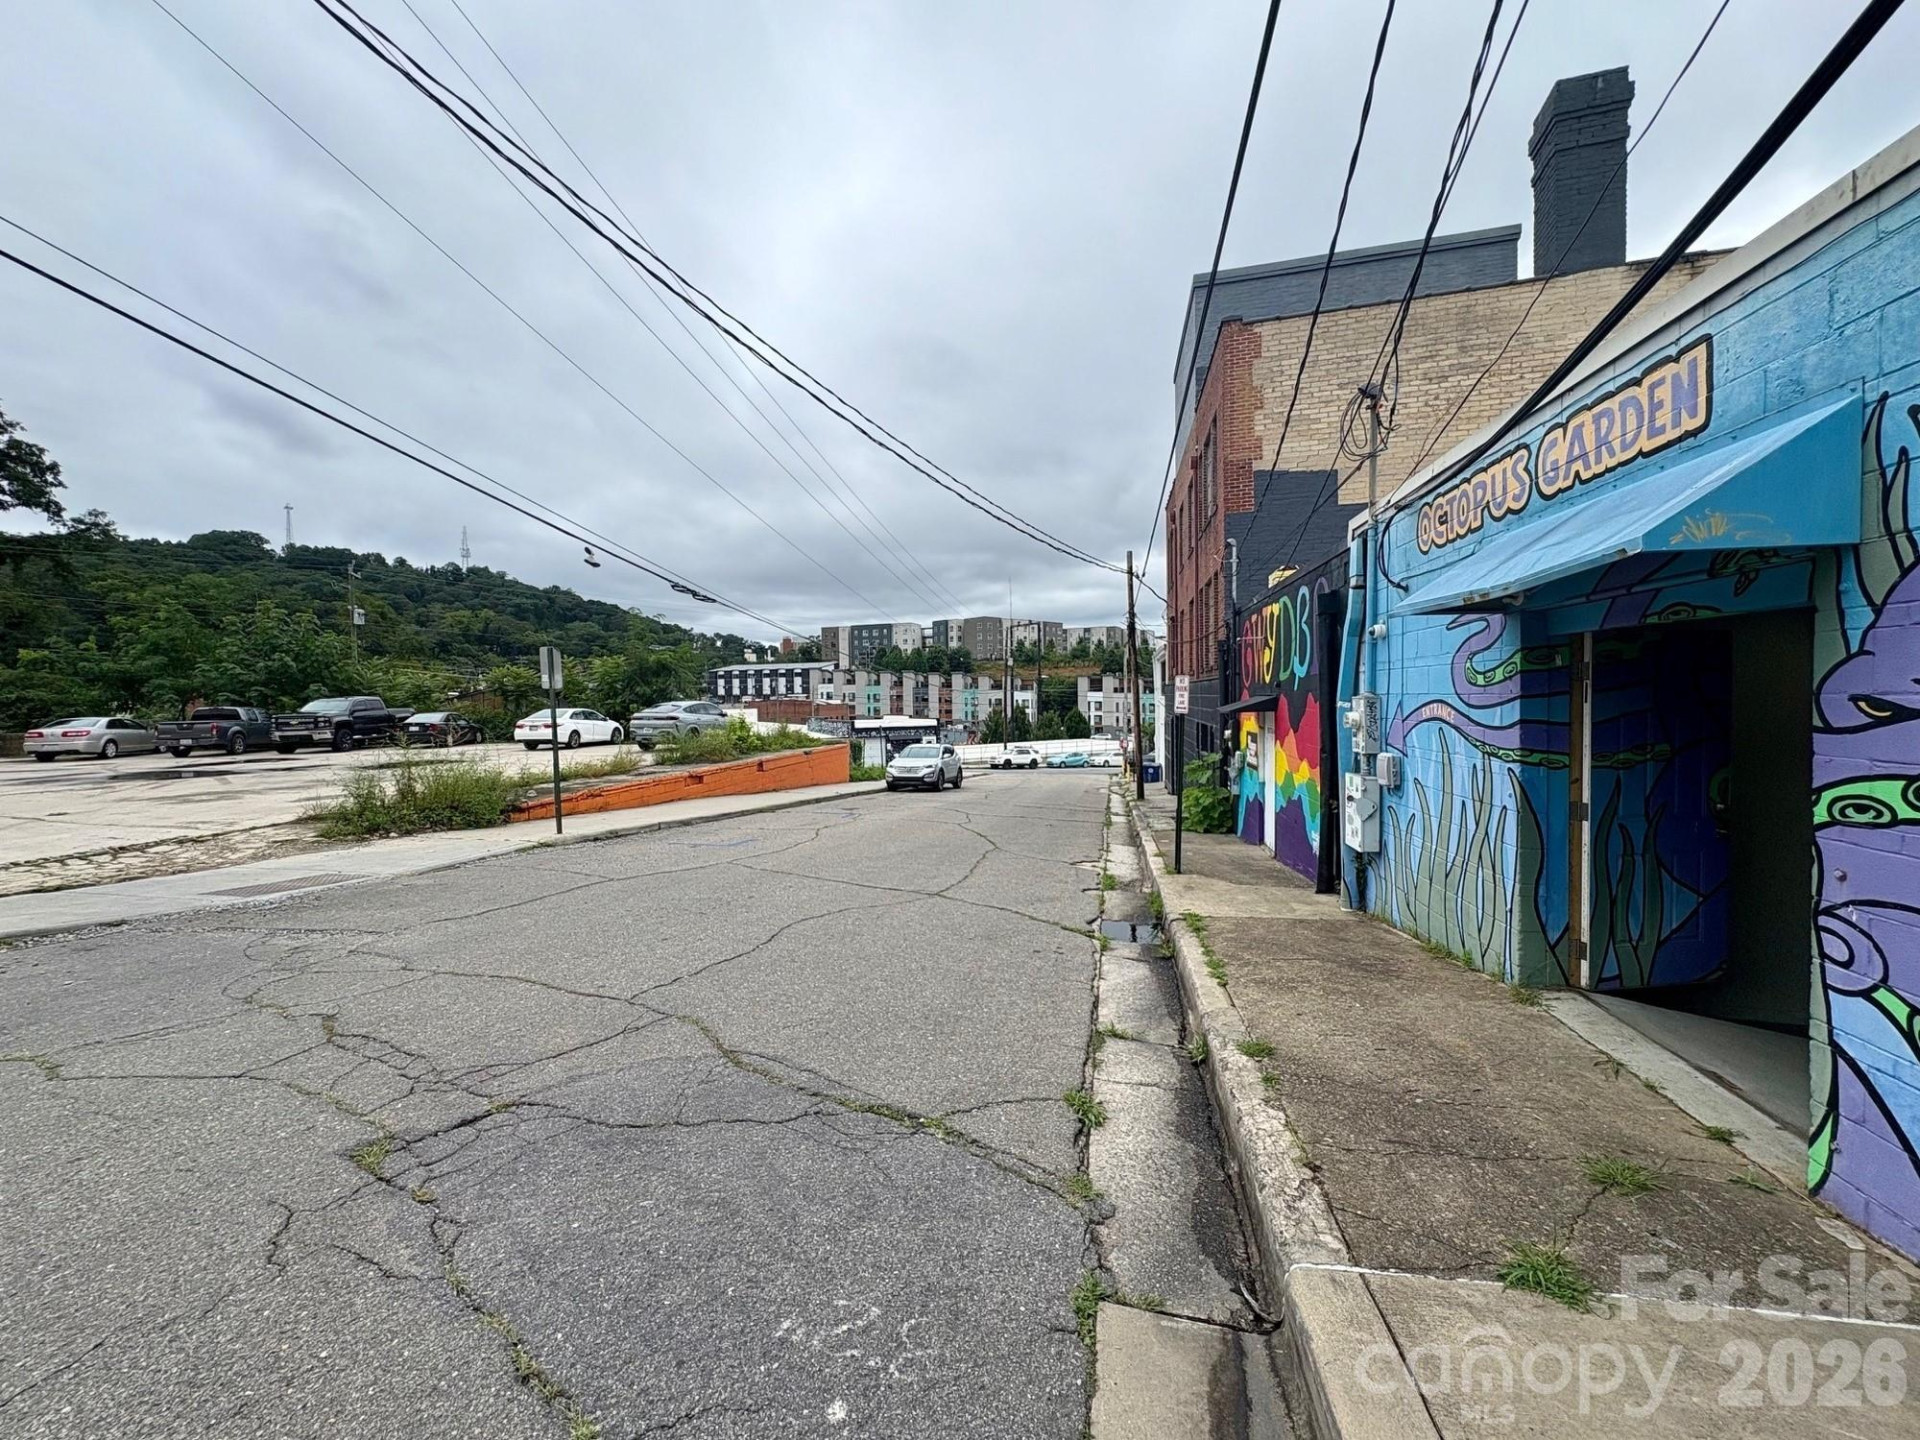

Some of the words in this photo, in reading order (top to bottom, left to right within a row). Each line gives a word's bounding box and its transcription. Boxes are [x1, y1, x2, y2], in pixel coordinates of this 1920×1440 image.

[1418, 447, 1531, 552] OCTOPUS
[1539, 343, 1707, 497] GARDEN
[1422, 703, 1454, 722] ENTRANCE
